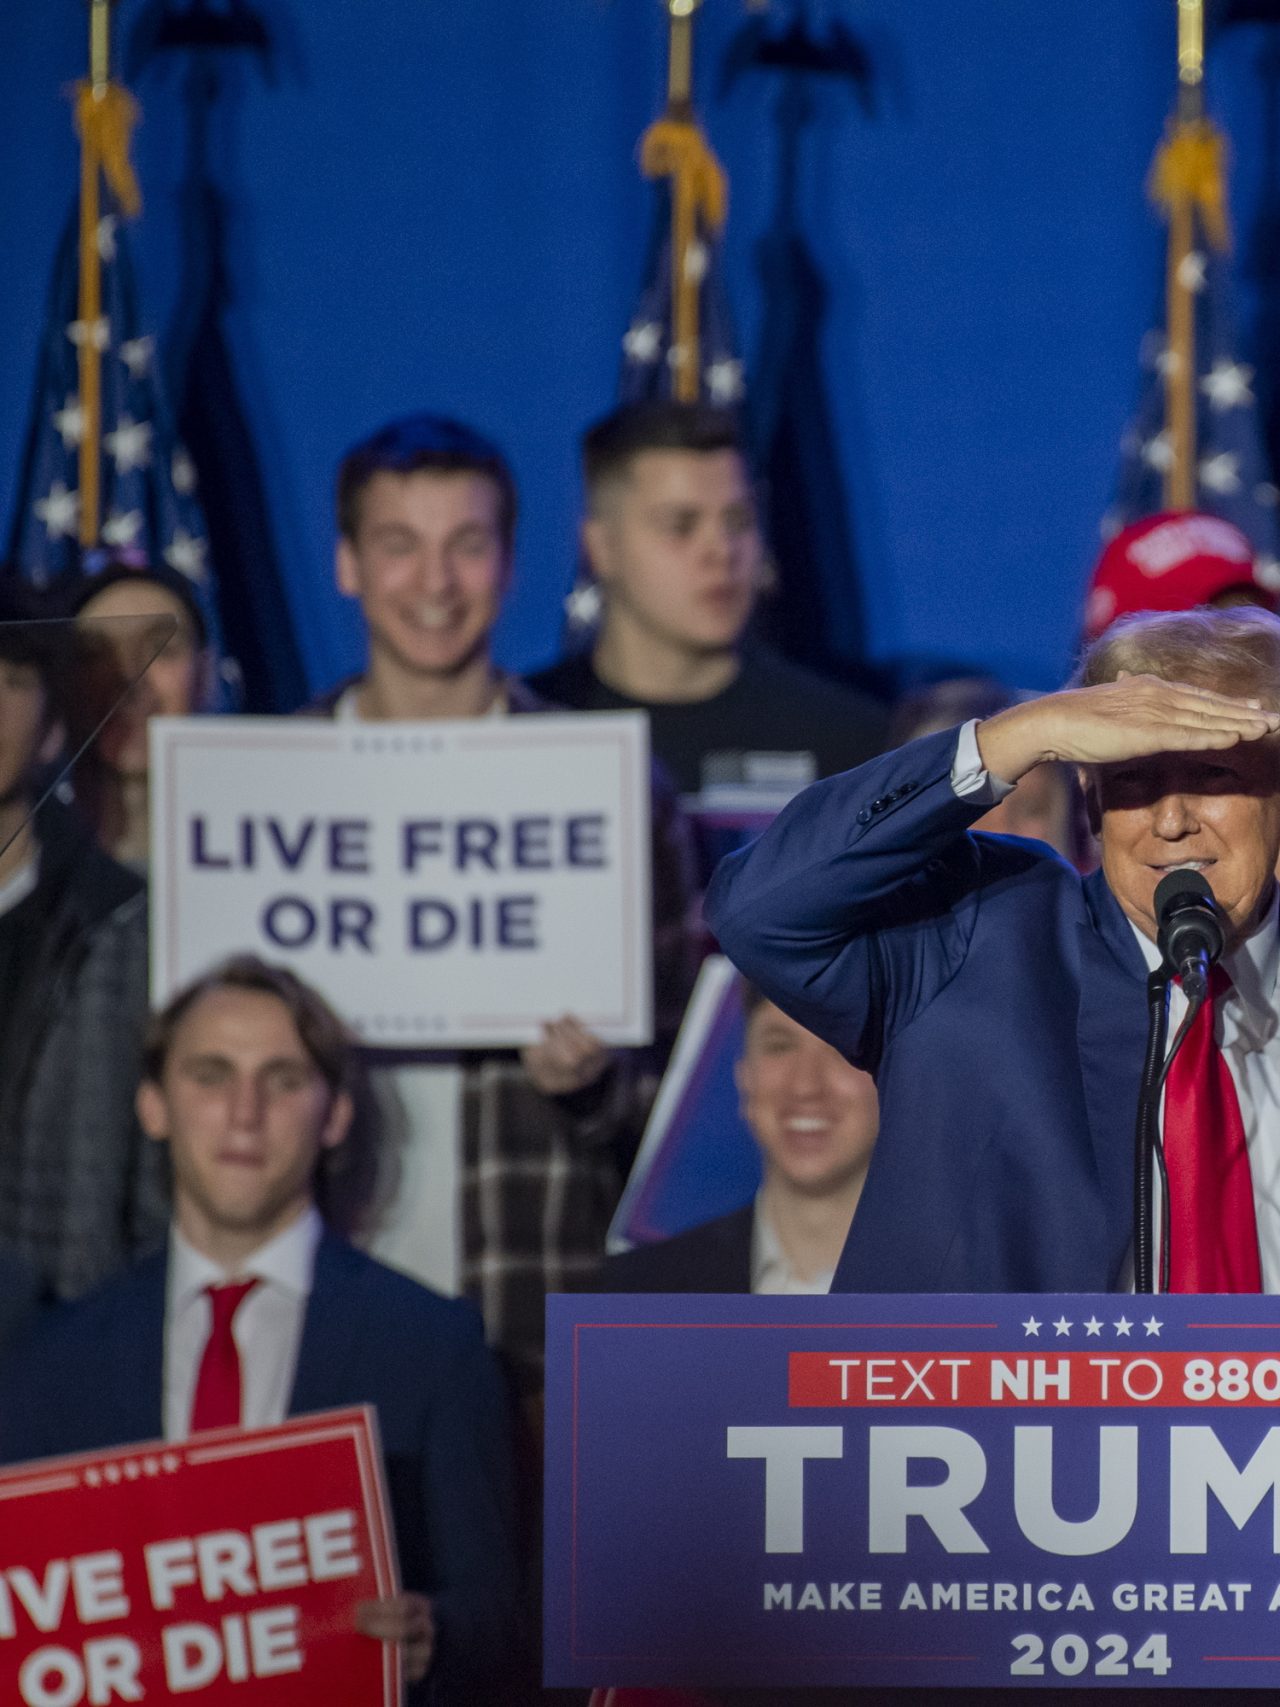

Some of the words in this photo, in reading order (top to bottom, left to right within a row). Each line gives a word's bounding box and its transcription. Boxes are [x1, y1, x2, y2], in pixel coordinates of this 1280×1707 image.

[189, 815, 371, 874] LIVE
[403, 814, 609, 871] FREE
[260, 897, 376, 951] OR
[407, 895, 539, 953] DIE
[828, 1358, 971, 1401] TEXT
[989, 1358, 1071, 1401] NH
[1089, 1358, 1164, 1401] TO
[0, 1549, 130, 1639] IVE
[143, 1508, 363, 1612] FREE
[762, 1582, 883, 1612] MAKE
[898, 1582, 1096, 1612] AMERICA
[1111, 1582, 1252, 1612] GREAT
[18, 1633, 147, 1707] OR
[160, 1603, 306, 1696] DIE
[1009, 1633, 1173, 1677] 2024
